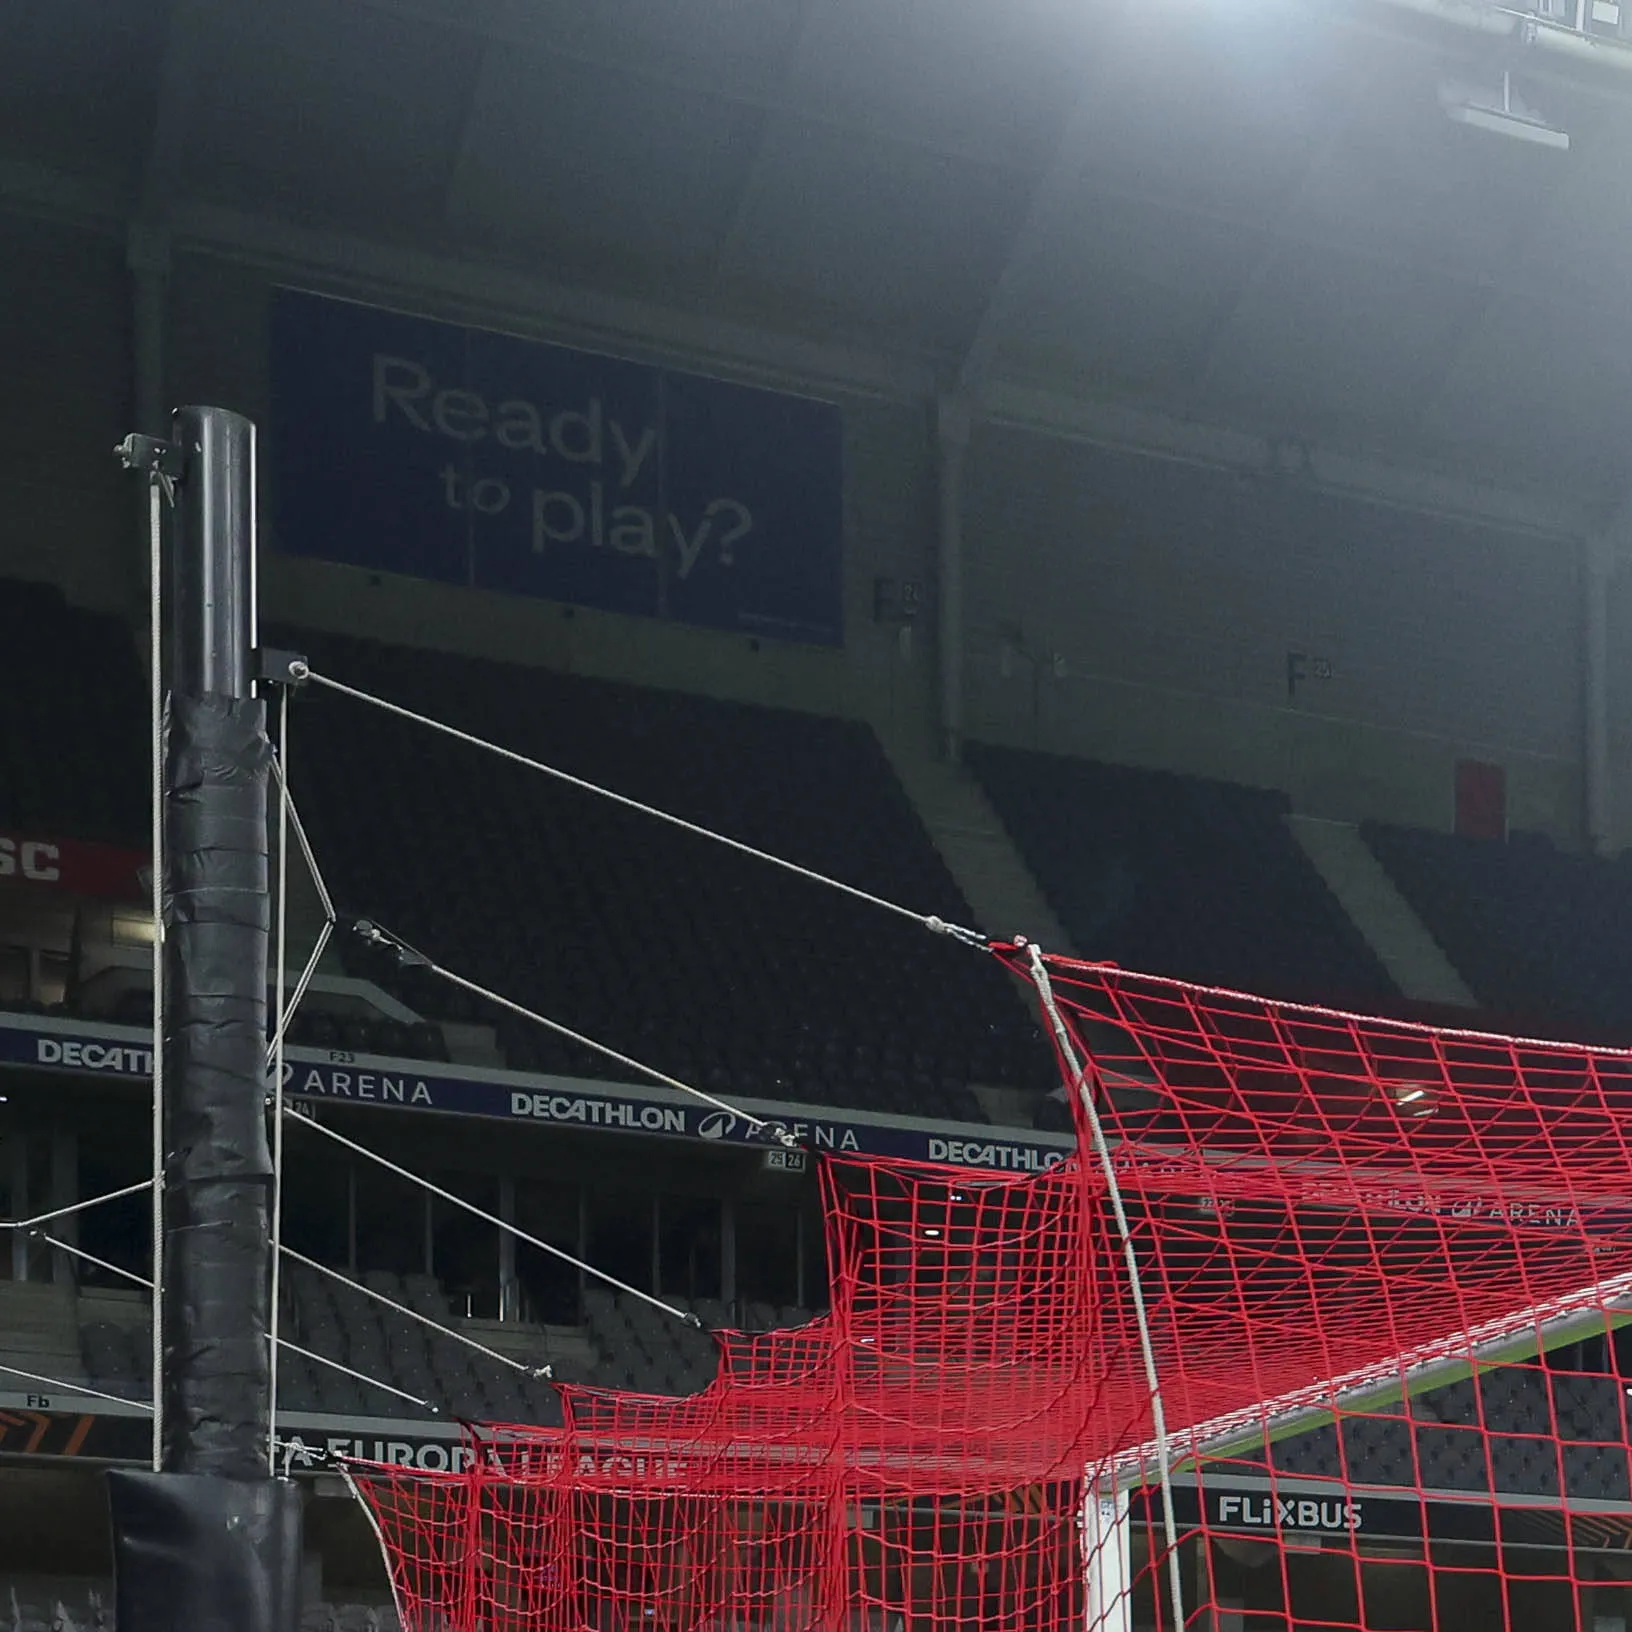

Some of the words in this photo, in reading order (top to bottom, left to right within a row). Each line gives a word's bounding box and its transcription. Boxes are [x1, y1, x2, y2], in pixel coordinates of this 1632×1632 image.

[372, 355, 656, 487] Ready
[441, 462, 510, 515] to
[533, 478, 753, 580] play?
[37, 1038, 153, 1074] DECAT
[304, 1069, 433, 1105] ARENA
[329, 1051, 356, 1065] F23
[510, 1091, 686, 1134] DECATHLON
[744, 1121, 860, 1152] AENA
[787, 1153, 802, 1168] 26
[27, 1395, 50, 1409] Fb
